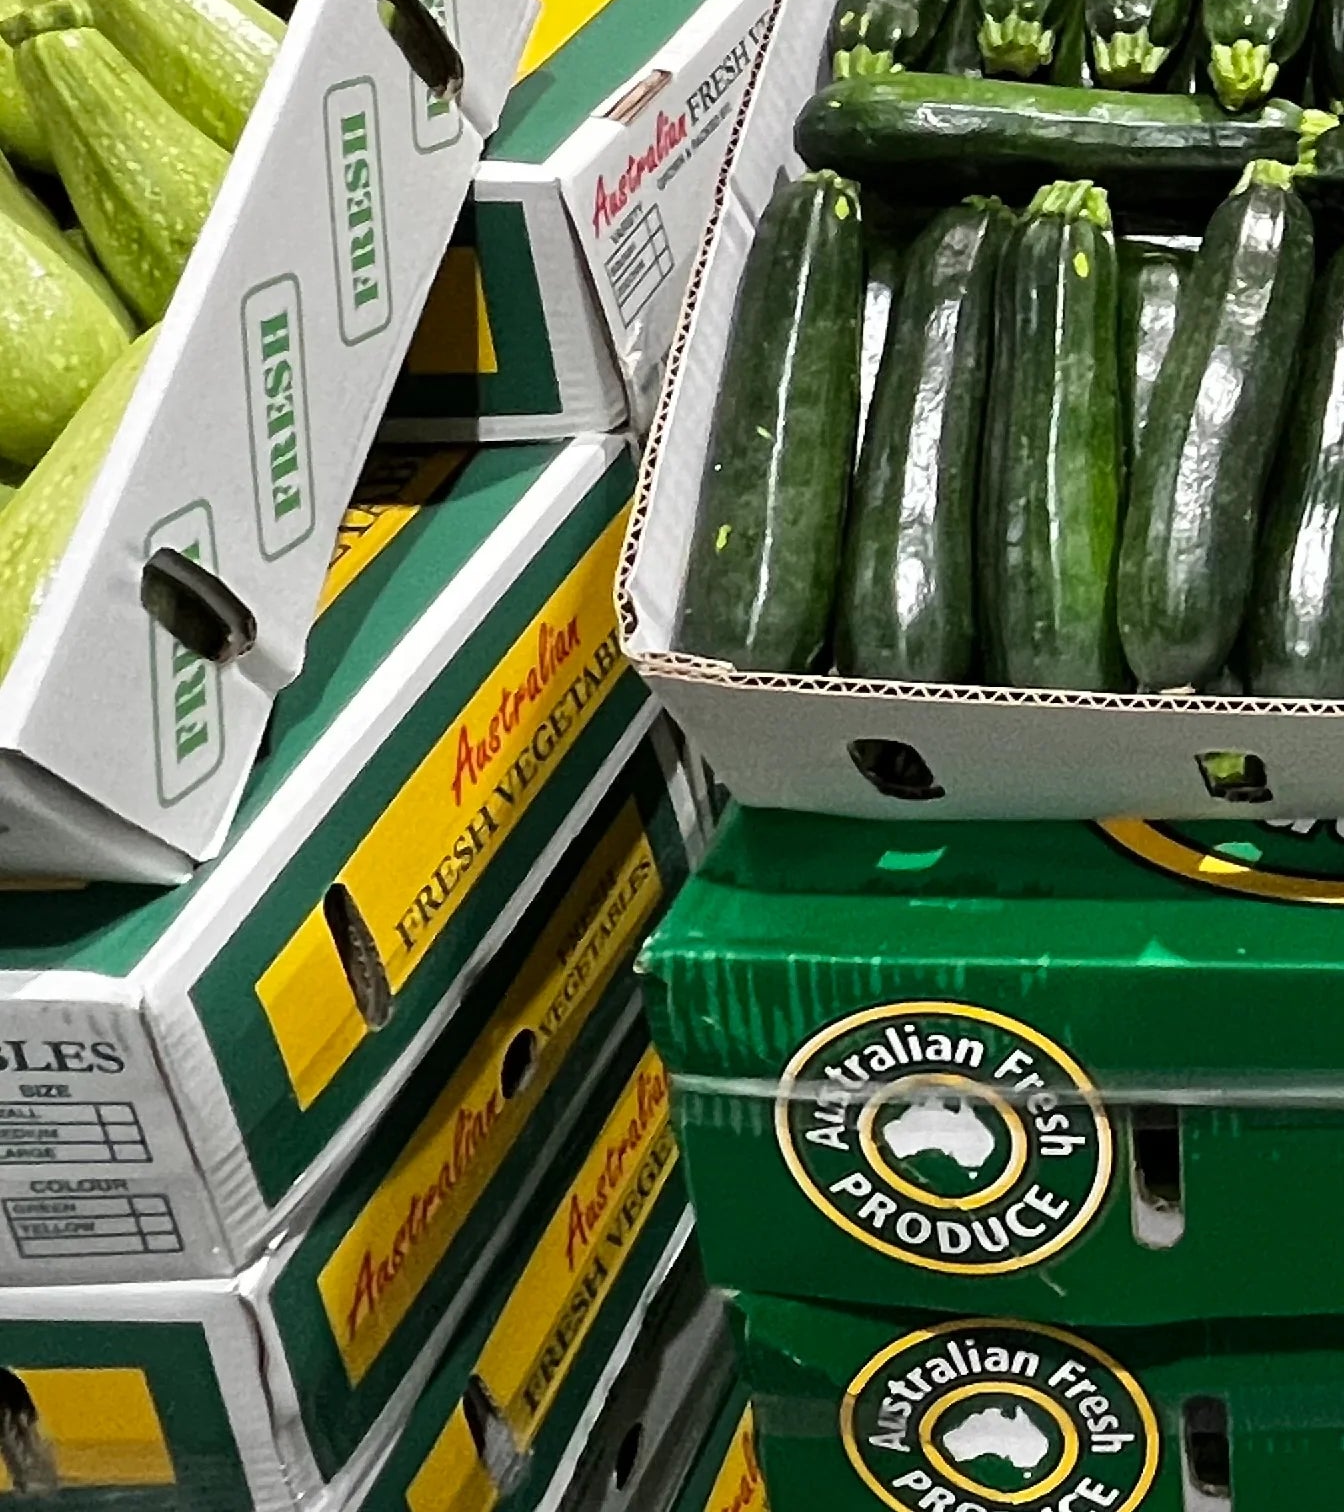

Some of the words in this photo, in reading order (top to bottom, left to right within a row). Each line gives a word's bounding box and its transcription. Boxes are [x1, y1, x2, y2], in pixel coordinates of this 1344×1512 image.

[340, 109, 380, 311] FRESH
[592, 109, 689, 239] Australian
[685, 38, 752, 124] FRESH
[260, 307, 303, 523] FRESH
[451, 616, 581, 807] Australian
[393, 805, 500, 953] FRESH
[538, 859, 653, 1042] VEGETABLES
[804, 1023, 985, 1152] Australian
[993, 1048, 1086, 1157] Fresh
[30, 1178, 130, 1194] COLOUR
[348, 1088, 503, 1343] Australian
[829, 1171, 1072, 1256] PRODUCE
[520, 1256, 610, 1413] FRESH
[868, 1338, 1040, 1453] Australian
[1047, 1358, 1135, 1454] Fresh
